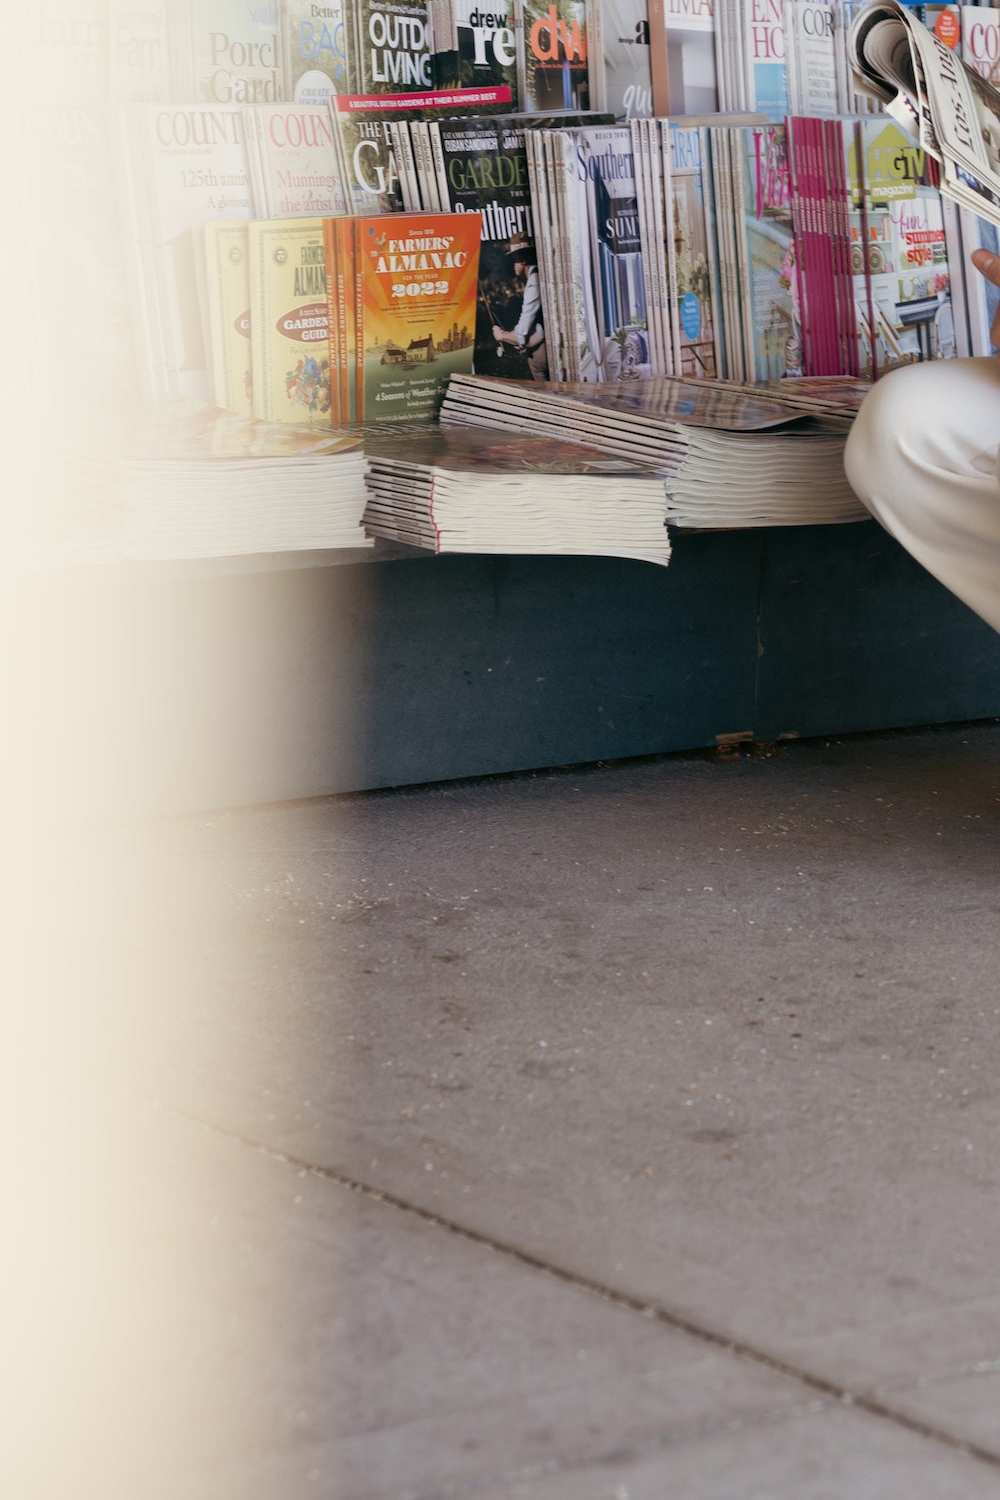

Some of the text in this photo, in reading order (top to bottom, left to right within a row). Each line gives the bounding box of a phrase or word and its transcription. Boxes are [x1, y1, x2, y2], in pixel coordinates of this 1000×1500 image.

[310, 3, 340, 20] Better
[469, 7, 507, 28] drew
[399, 99, 424, 108] GARDENS
[453, 94, 479, 103] SUMMER
[480, 92, 497, 100] BEST
[357, 122, 381, 138] THE
[873, 183, 913, 198] magazine
[375, 252, 467, 274] ALMANAC
[907, 247, 932, 266] style
[391, 281, 449, 298] 2022
[382, 390, 404, 402] Seasons
[412, 388, 437, 399] Weather
